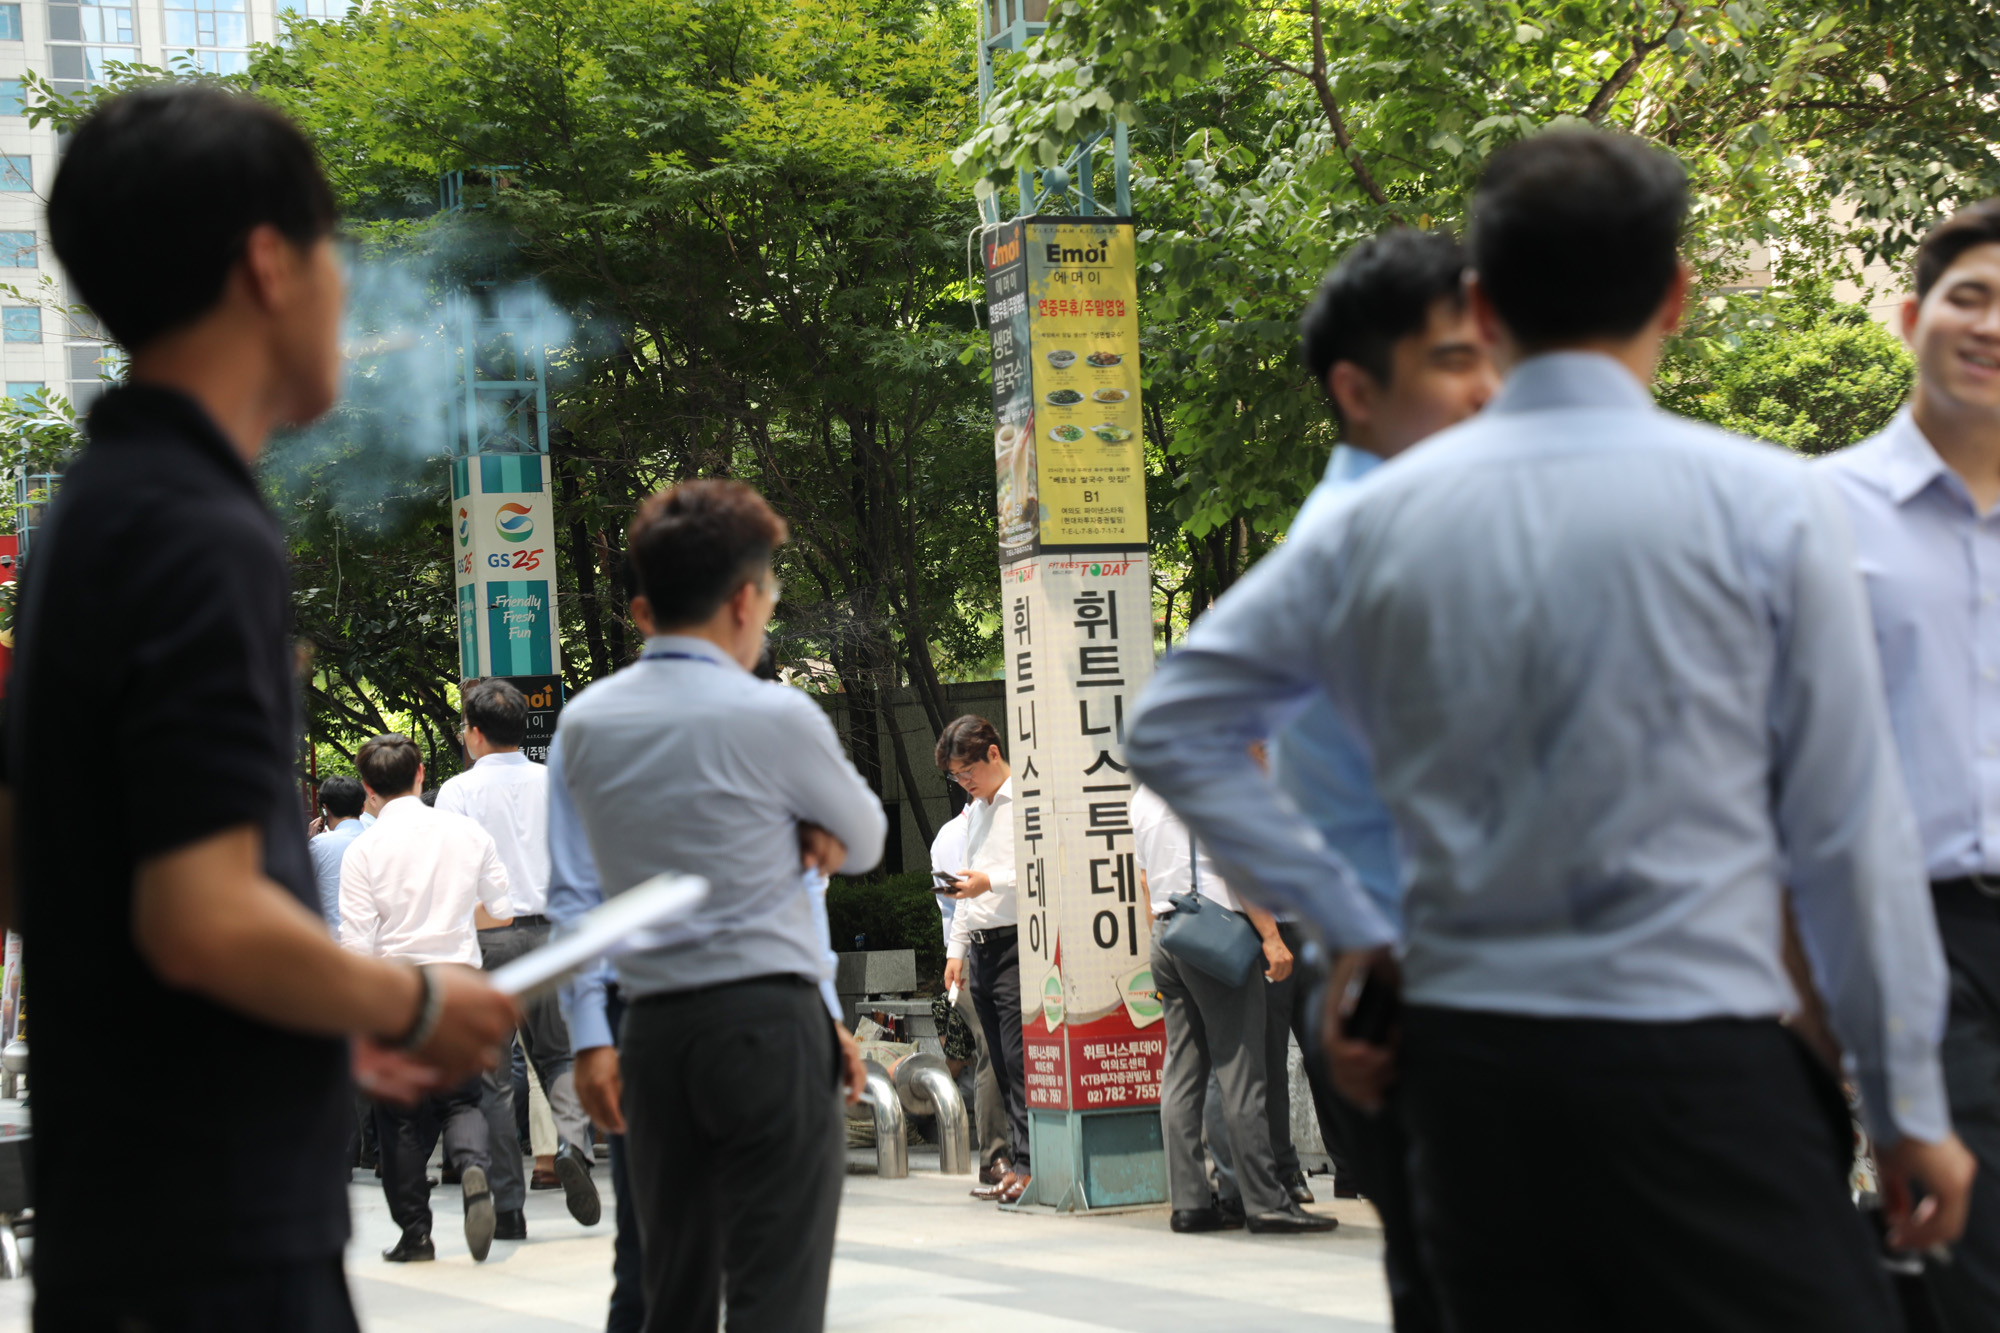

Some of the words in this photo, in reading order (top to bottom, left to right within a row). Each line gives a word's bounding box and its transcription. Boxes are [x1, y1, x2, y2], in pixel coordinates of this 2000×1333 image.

[1053, 271, 1101, 285] 에머이
[1038, 299, 1125, 317] 연중무휴/주말영업
[1084, 491, 1099, 502] B1
[488, 549, 544, 571] GS25
[495, 595, 541, 610] Friendly
[503, 611, 535, 624] Fresh
[509, 626, 531, 640] Fun
[1013, 596, 1048, 960] 휘트니스투데이
[1073, 590, 1138, 956] 휘트니스투데이
[1083, 1040, 1162, 1060] 휘트니스투데이
[1101, 1057, 1147, 1071] 여의도센터
[1080, 1070, 1151, 1086] KTB투자증권빌딩
